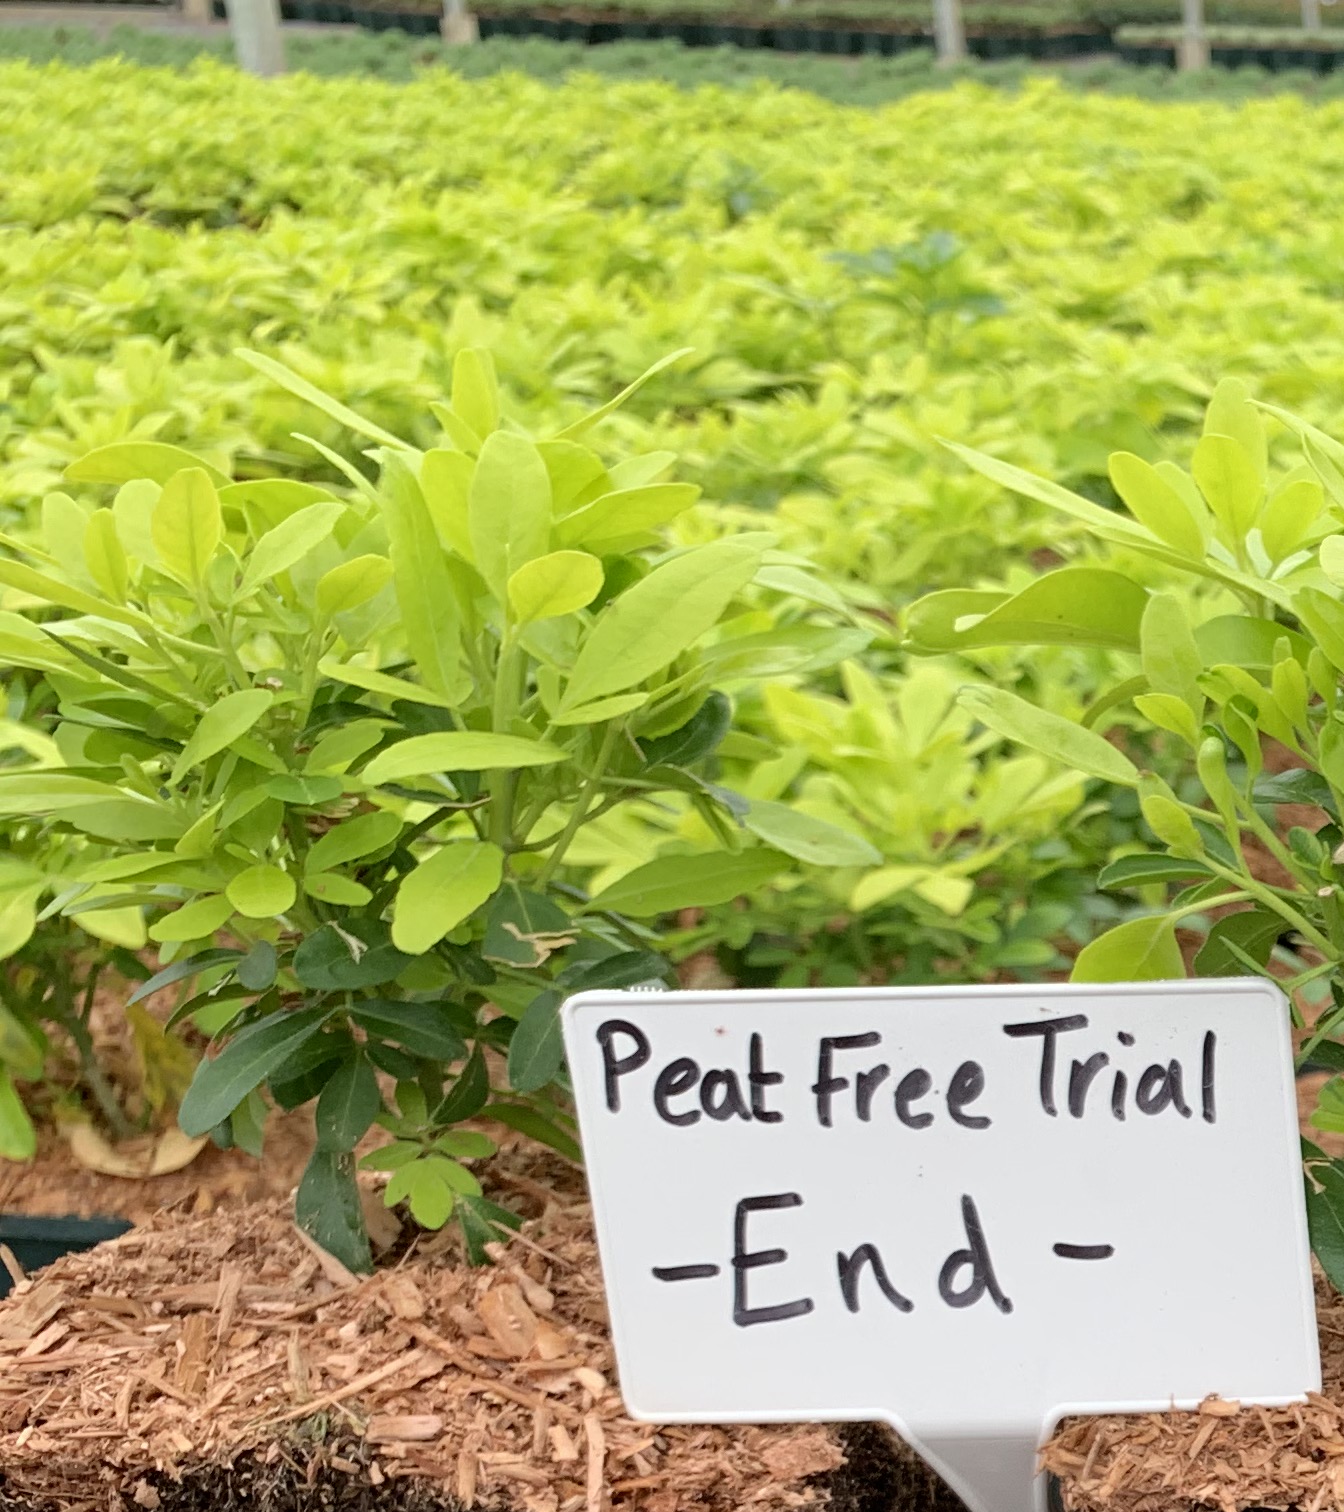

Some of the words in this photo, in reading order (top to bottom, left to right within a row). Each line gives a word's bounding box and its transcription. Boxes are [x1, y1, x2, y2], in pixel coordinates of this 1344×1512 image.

[595, 1019, 784, 1127] Peat
[810, 1031, 992, 1130] Free
[1002, 1013, 1217, 1124] Trial
